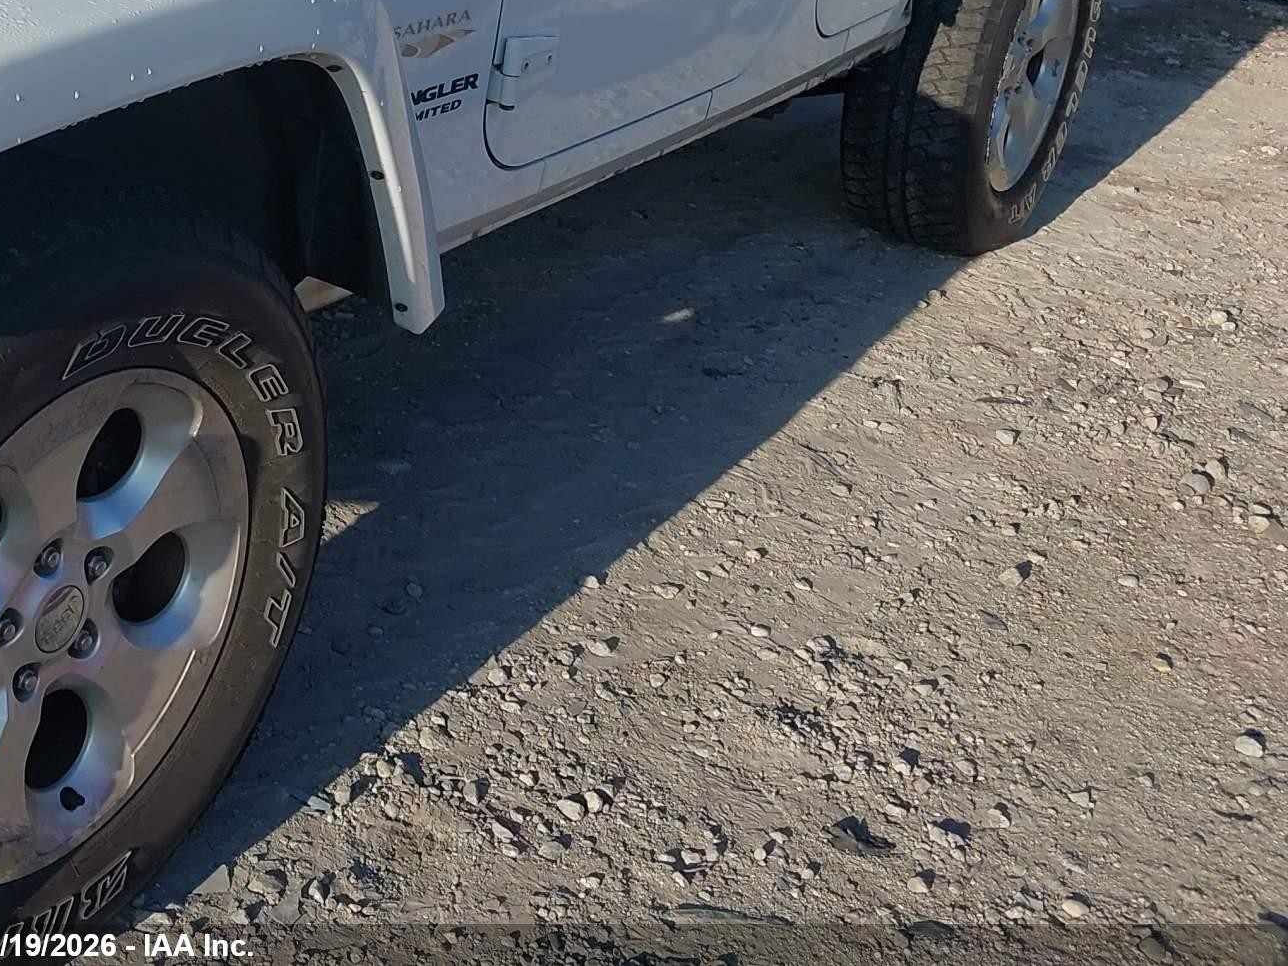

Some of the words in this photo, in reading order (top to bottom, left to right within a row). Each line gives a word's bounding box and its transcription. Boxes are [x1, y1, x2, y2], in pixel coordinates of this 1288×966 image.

[392, 9, 472, 40] SAHARA
[62, 313, 304, 457] DUELER
[263, 486, 306, 649] A/T
